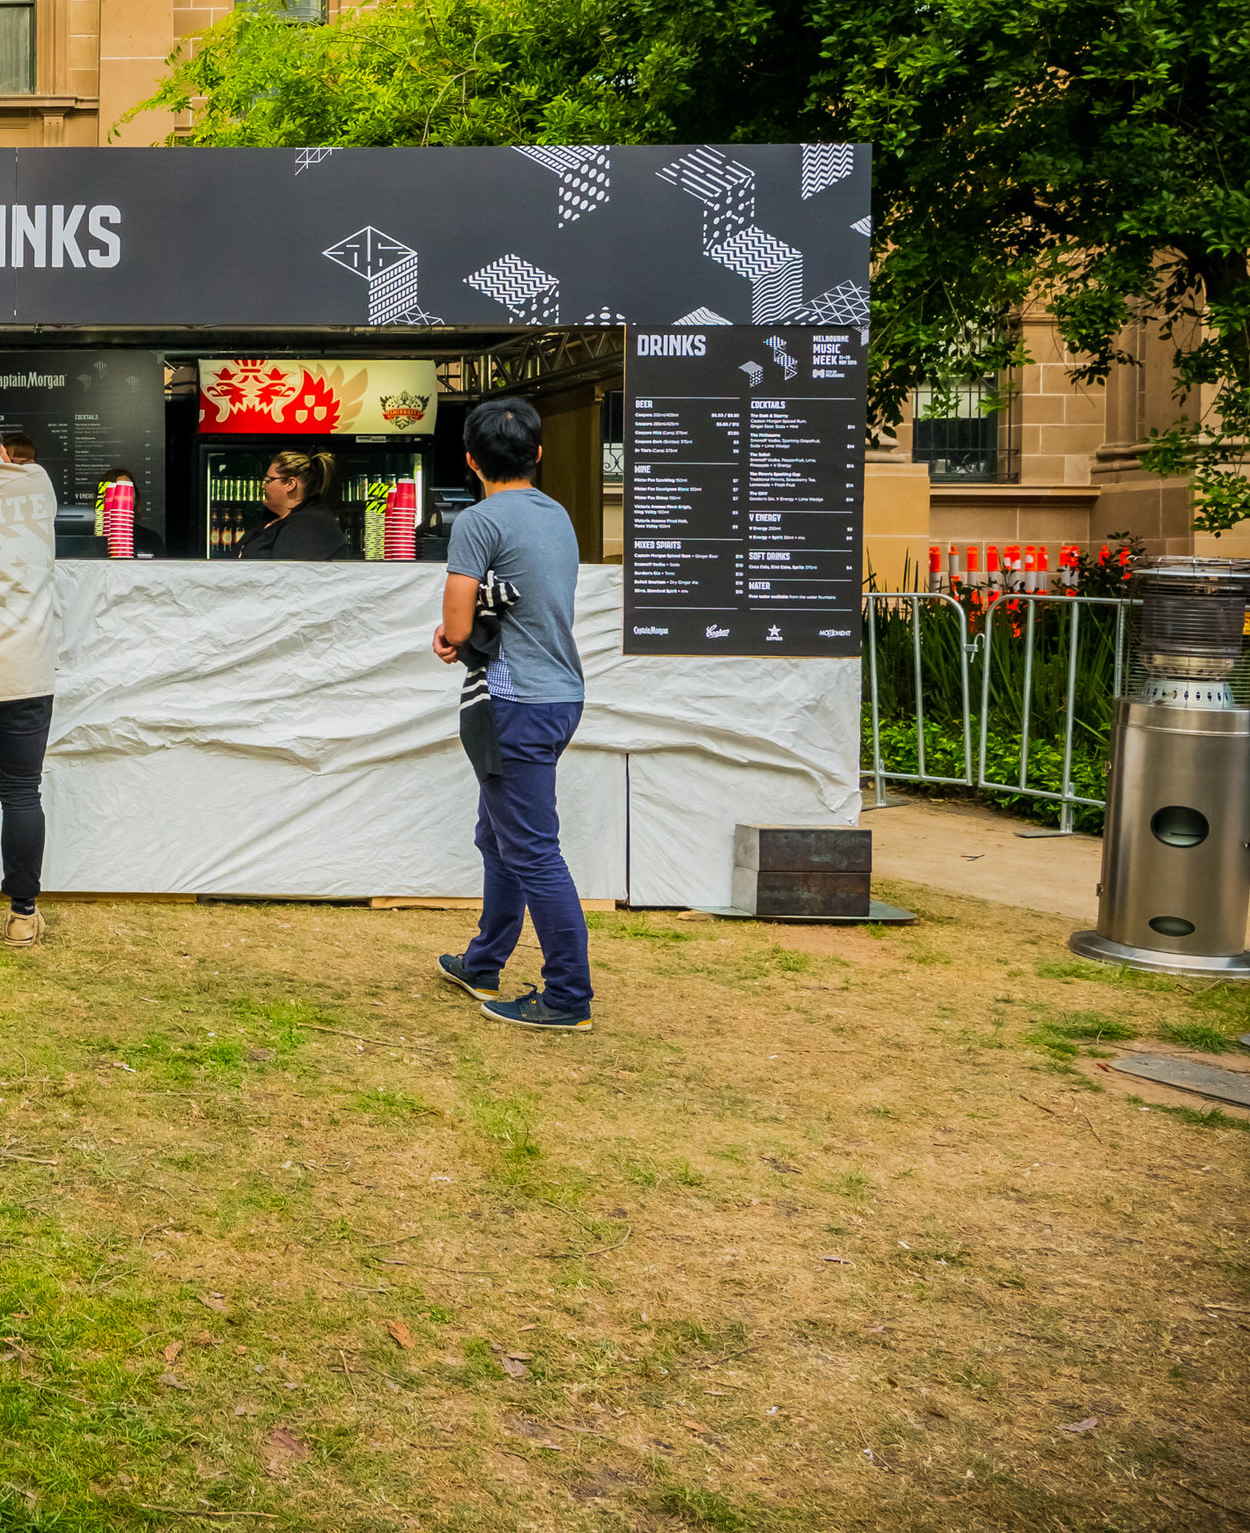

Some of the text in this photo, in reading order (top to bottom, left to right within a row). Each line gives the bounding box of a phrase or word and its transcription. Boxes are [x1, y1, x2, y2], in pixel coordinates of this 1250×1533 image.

[637, 335, 706, 356] DRINKS
[813, 344, 840, 353] MUSIC
[813, 355, 837, 365] WEEK
[27, 372, 65, 389] Morgan
[635, 400, 653, 408] BEER
[751, 401, 785, 409] COCKTAILS
[634, 465, 651, 473] WINE
[756, 514, 781, 522] ENERGY
[634, 541, 681, 549] MIXED SPIRITS
[749, 582, 770, 590] WATER
